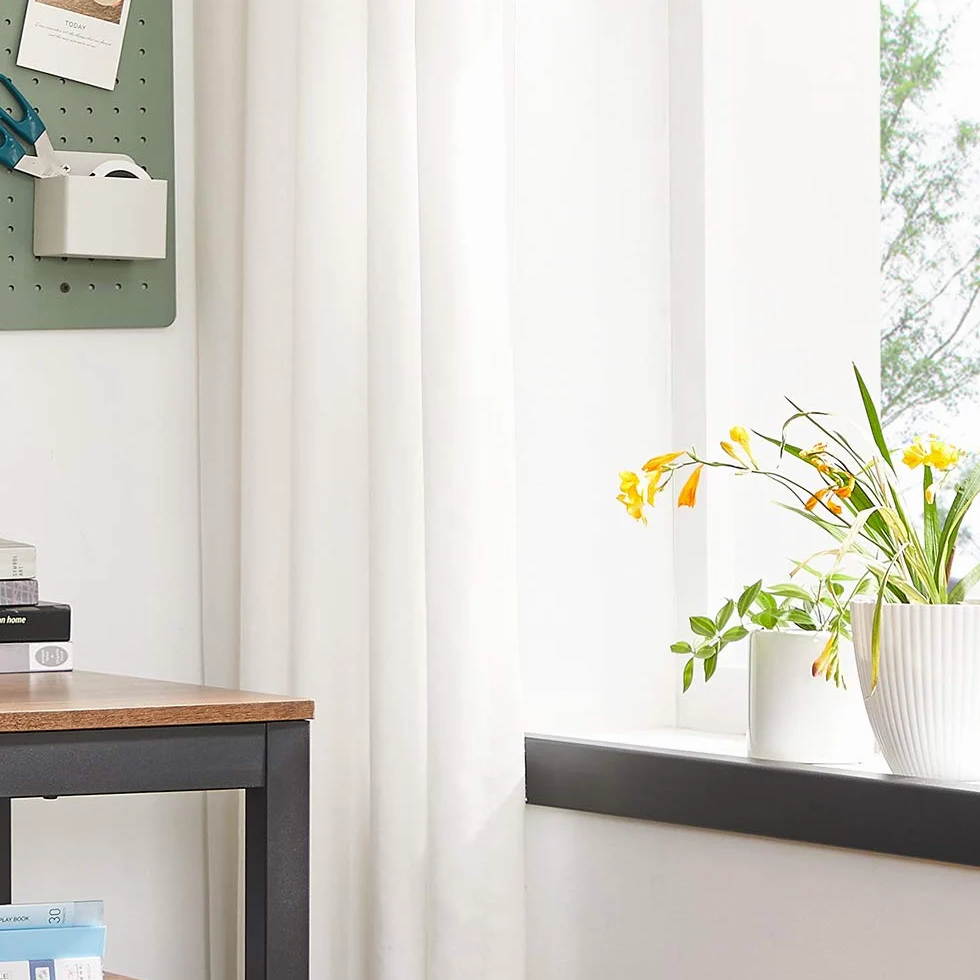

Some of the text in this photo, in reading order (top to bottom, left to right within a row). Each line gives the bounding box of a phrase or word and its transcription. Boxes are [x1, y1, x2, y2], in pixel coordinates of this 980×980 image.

[65, 20, 86, 30] TODAY
[7, 616, 26, 624] home
[48, 908, 61, 924] 30
